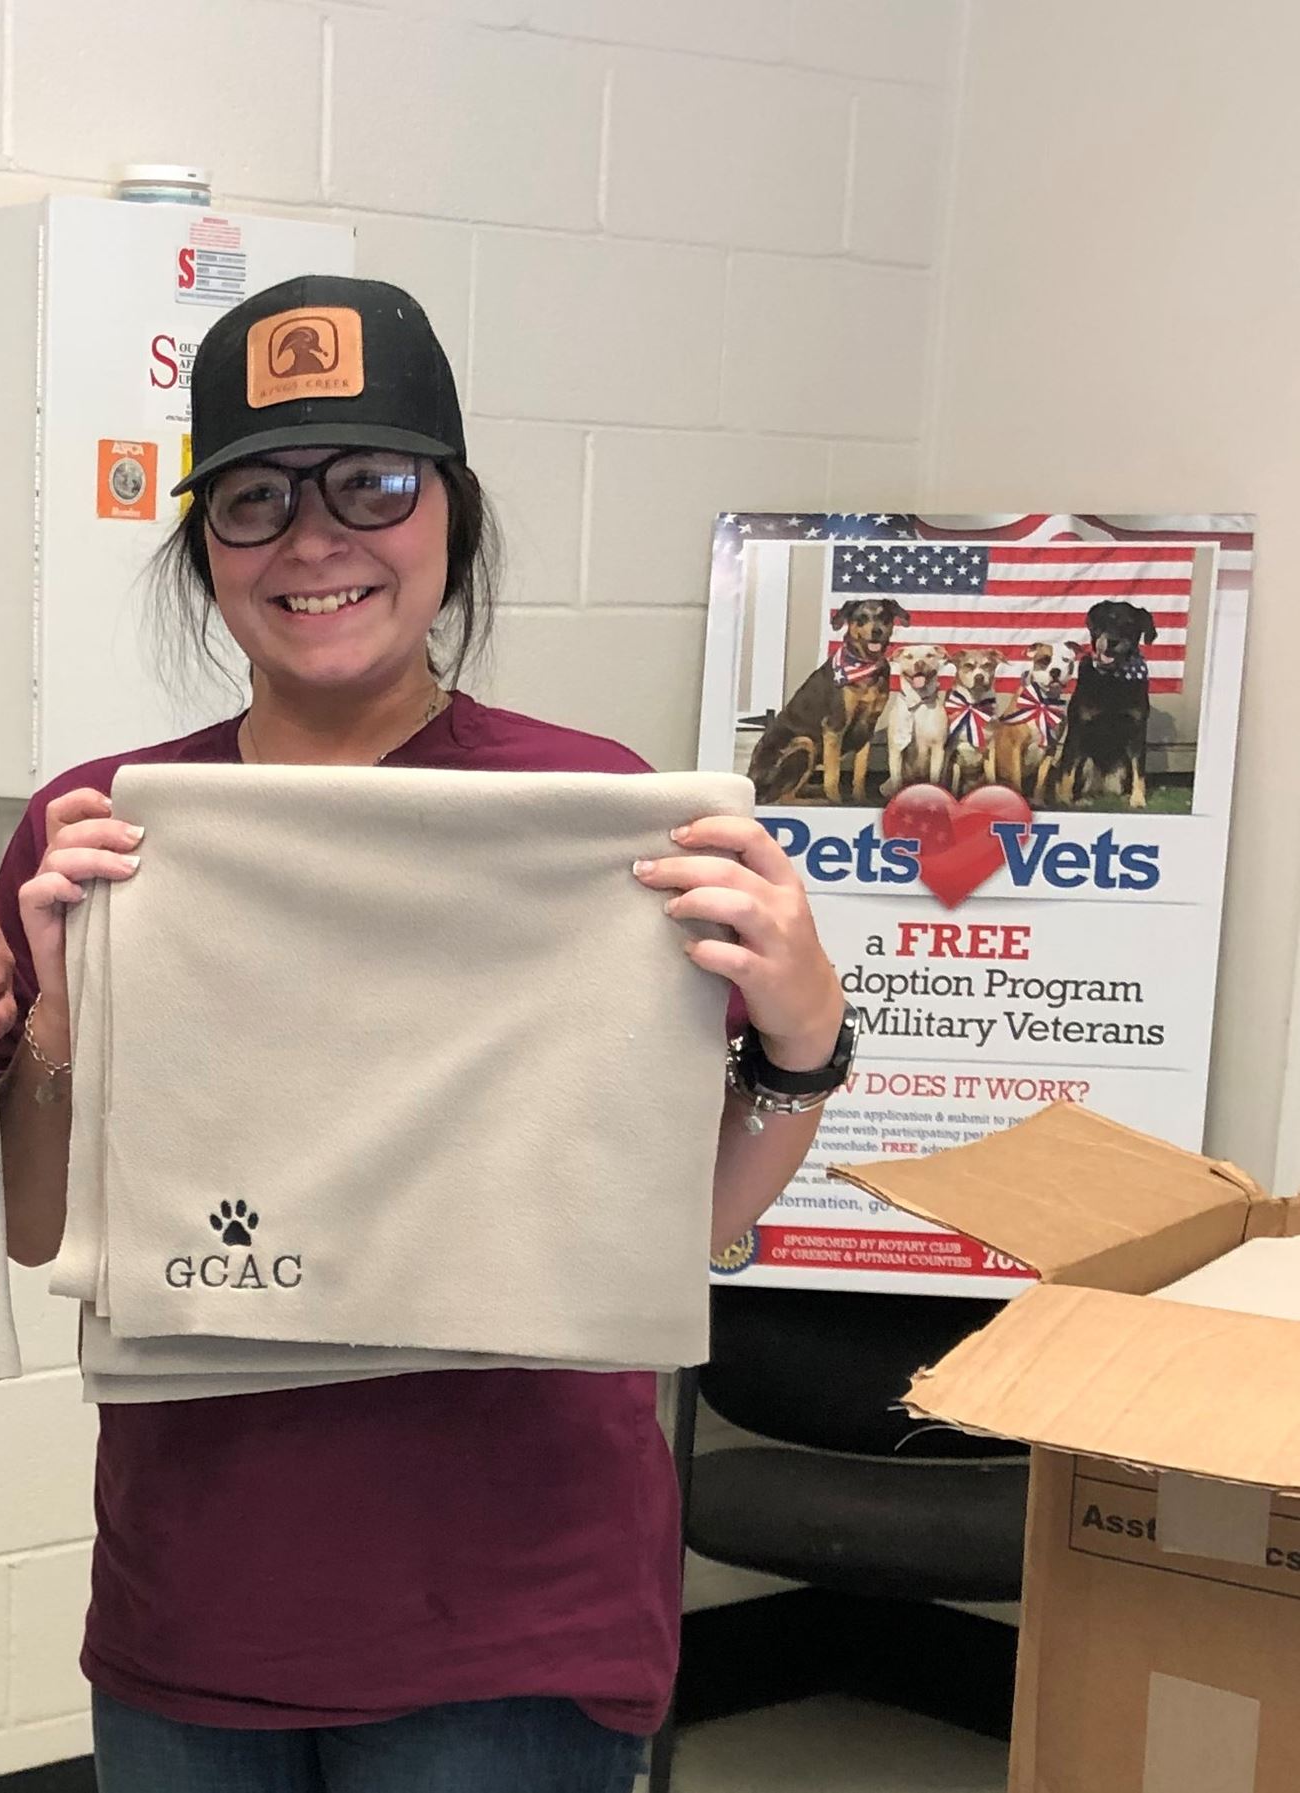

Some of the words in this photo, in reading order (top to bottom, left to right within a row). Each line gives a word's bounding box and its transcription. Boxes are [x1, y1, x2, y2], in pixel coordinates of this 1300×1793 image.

[991, 821, 1161, 891] Vets
[866, 934, 886, 956] a
[895, 923, 1032, 960] FREE
[837, 965, 974, 1002] doption
[984, 970, 1143, 1007] Program
[856, 1006, 997, 1047] Military
[1003, 1011, 1165, 1045] Veterans
[866, 1073, 946, 1097] DOES
[953, 1077, 981, 1099] IT
[981, 1078, 1090, 1103] WORK?
[864, 1110, 933, 1124] application
[947, 1112, 990, 1124] submit
[992, 1114, 1006, 1125] to
[852, 1125, 878, 1137] with
[881, 1127, 961, 1142] participating
[821, 1140, 879, 1152] conclude
[881, 1142, 918, 1153] FREE
[868, 1200, 890, 1214] go
[783, 1234, 857, 1249] SPONSORED
[860, 1238, 875, 1249] BY
[878, 1239, 927, 1252] ROTARY
[929, 1242, 961, 1254] CLUB
[771, 1247, 788, 1259] OF
[791, 1248, 842, 1261] GREENE
[855, 1252, 907, 1265] PUTNAM
[908, 1256, 972, 1268] COUNTIES
[165, 1253, 303, 1290] GCAC
